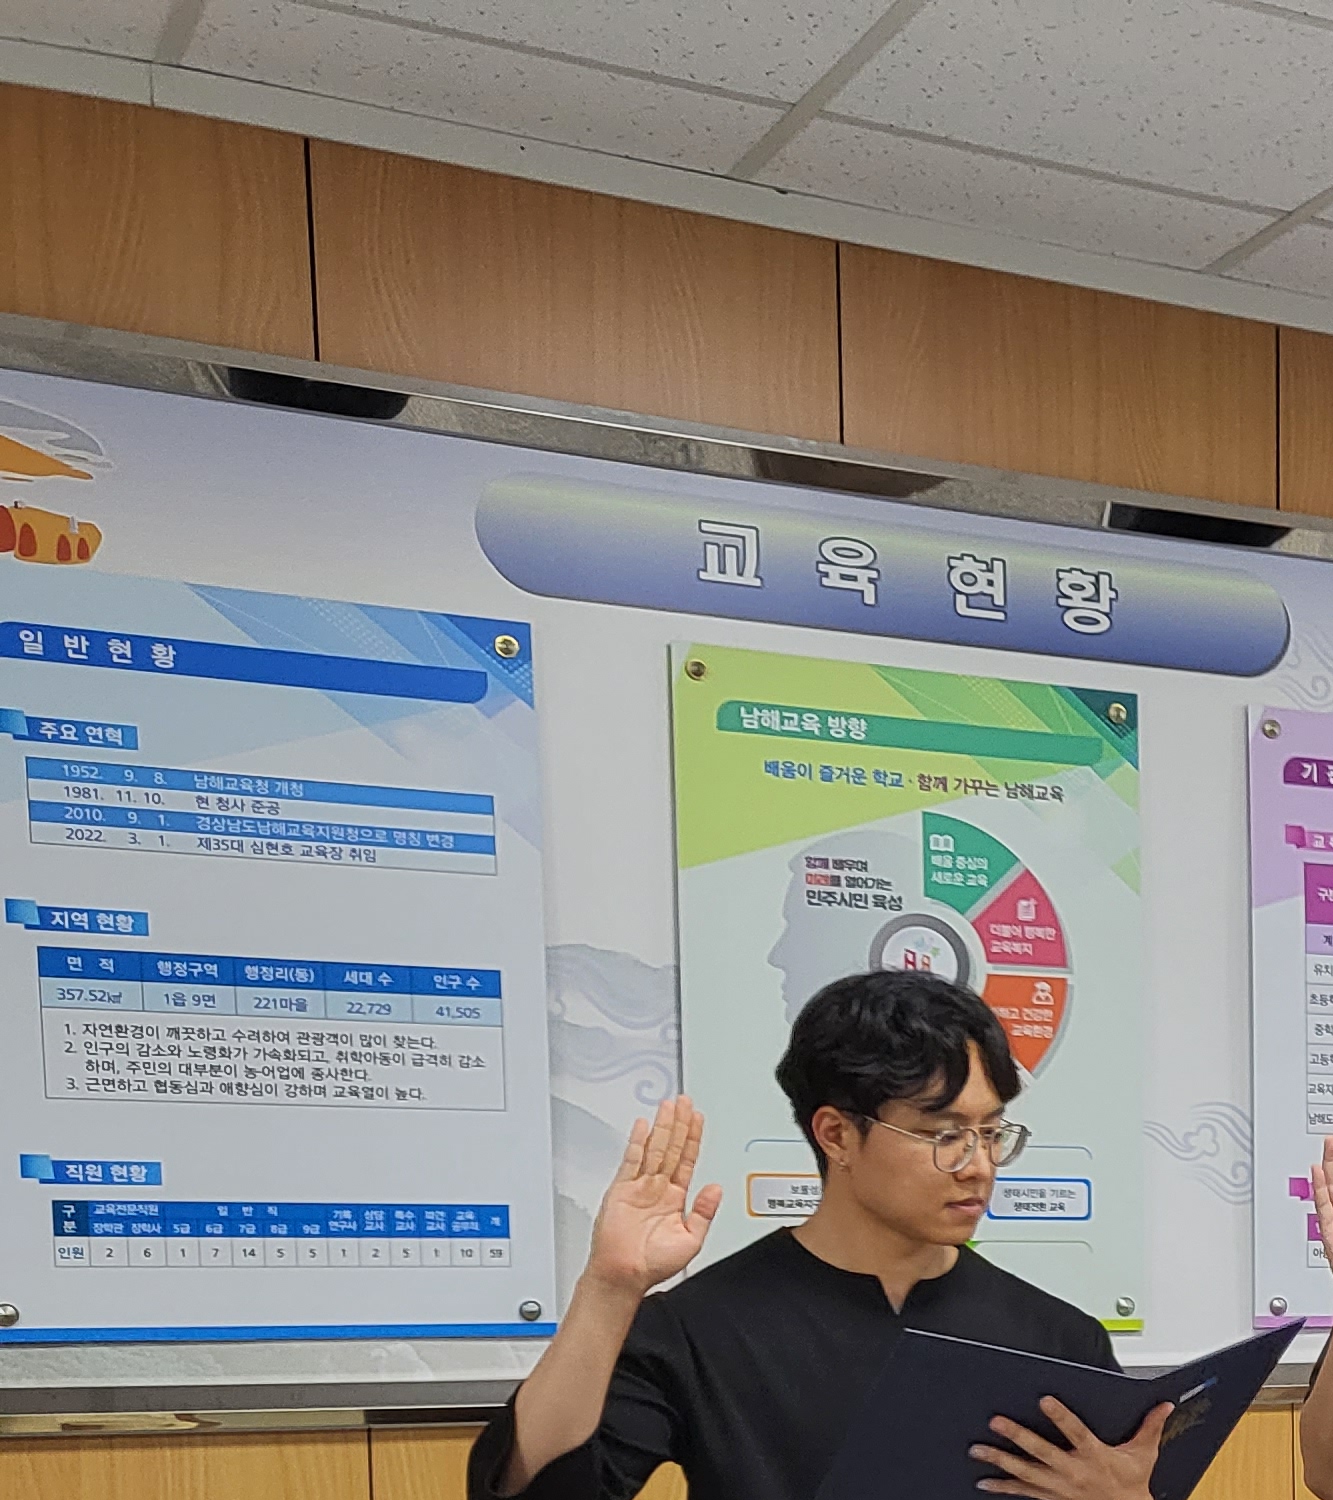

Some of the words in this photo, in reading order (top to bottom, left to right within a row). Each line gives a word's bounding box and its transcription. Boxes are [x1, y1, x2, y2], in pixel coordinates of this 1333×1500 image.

[40, 721, 79, 741] 주요
[85, 726, 124, 746] 연혁
[741, 706, 821, 736] 남해교육
[828, 716, 868, 741] 방향
[62, 764, 103, 780] 1952.
[193, 774, 269, 795] 남해교육청
[764, 759, 812, 781] 배움이
[819, 764, 867, 786] 즐거운
[873, 770, 904, 788] 학교
[917, 774, 948, 793] 함께
[954, 777, 999, 798] 가꾸는
[1004, 782, 1064, 803] 남해교육
[64, 786, 104, 800] 1981.
[116, 790, 137, 803] 11.
[144, 792, 165, 805] 10.
[195, 795, 210, 809] 현
[216, 797, 246, 813] 청사
[251, 799, 281, 815] 준공
[64, 806, 106, 821] 2010.
[196, 815, 388, 844] 경상남도남해교육지원청으로
[65, 828, 106, 842] 2022.
[197, 836, 244, 853] 제35대
[250, 841, 295, 856] 심현호
[300, 844, 343, 860] 교육장
[349, 847, 377, 863] 취임
[806, 890, 869, 909] 민주시민
[872, 893, 903, 911] 육성
[51, 911, 89, 930] 지역
[96, 913, 135, 933] 현황
[157, 960, 218, 979] 행정구역
[343, 970, 373, 986] 세대
[377, 971, 394, 987] 수
[433, 974, 463, 990] 인구
[466, 975, 482, 991] 수
[253, 996, 308, 1012] 221마을
[82, 1023, 160, 1040] 자연환경이
[165, 1026, 227, 1042] 깨끗하고
[231, 1028, 290, 1045] 수려하여
[296, 1031, 353, 1047] 관광객이
[359, 1033, 387, 1048] 많이
[83, 1040, 130, 1056] 인구의
[137, 1042, 182, 1058] 감소와
[187, 1045, 248, 1061] 노령화가
[336, 1051, 405, 1067] 취학아동이
[411, 1053, 452, 1068] 급격히
[457, 1055, 486, 1069] 감소
[85, 1059, 120, 1074] 하며,
[126, 1061, 172, 1076] 주민의
[178, 1063, 238, 1078] 대부분이
[85, 1077, 149, 1093] 근면하고
[153, 1079, 214, 1095] 협동심과
[219, 1081, 278, 1097] 애향심이
[284, 1083, 327, 1098] 강하며
[333, 1085, 389, 1100] 교육열이
[65, 1163, 103, 1182] 직원
[110, 1164, 147, 1182] 현황
[57, 1246, 85, 1260] 인원
